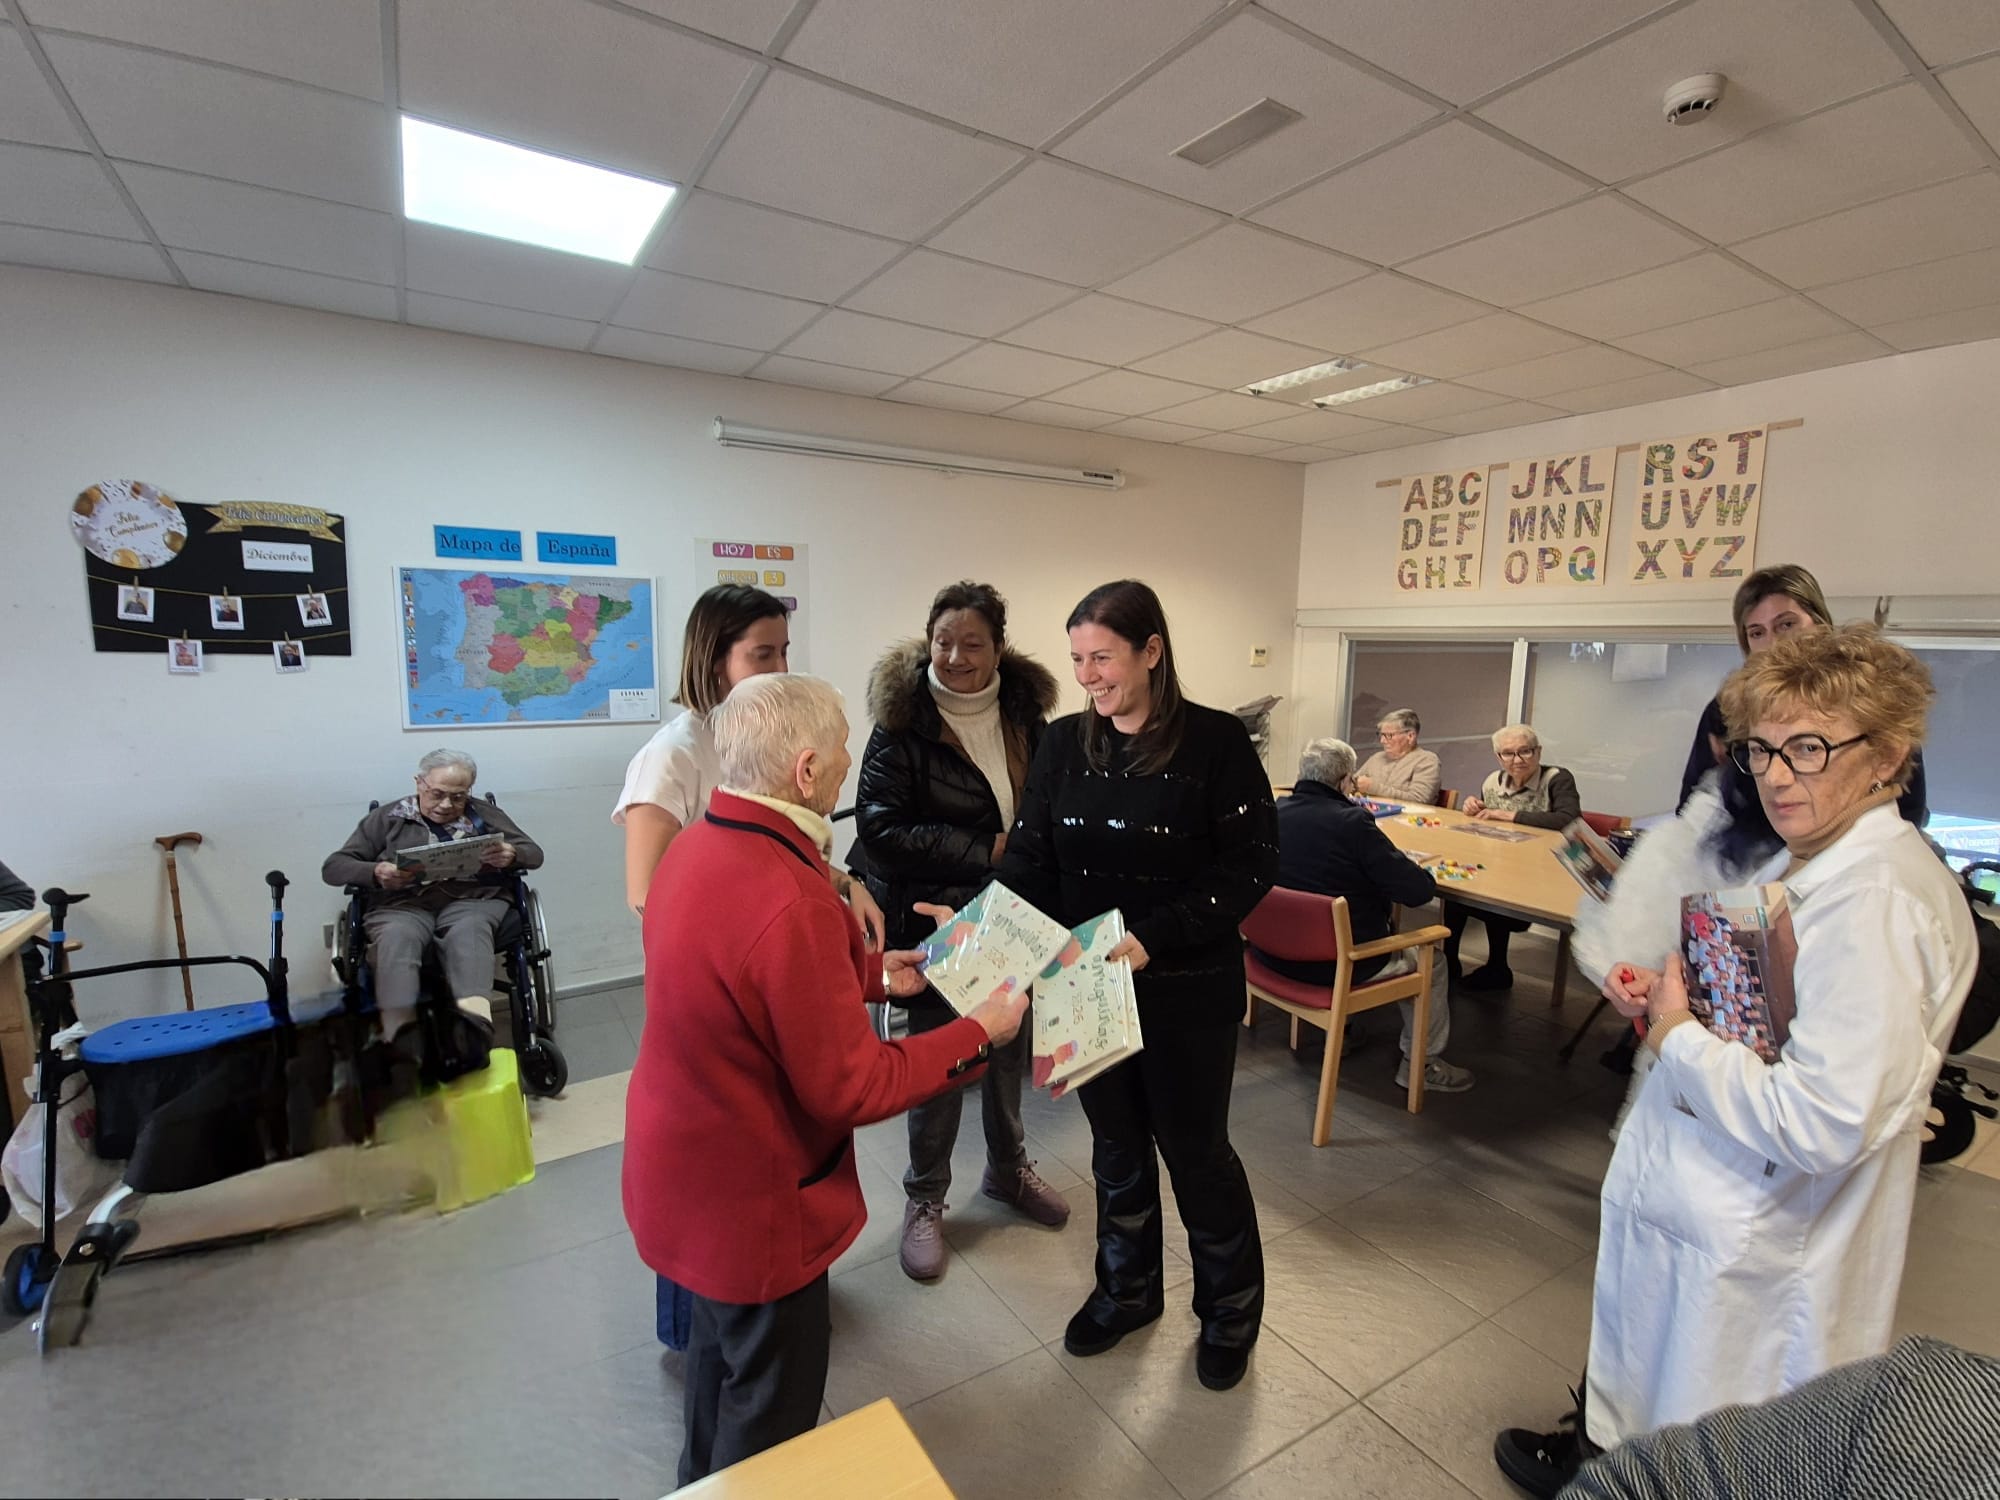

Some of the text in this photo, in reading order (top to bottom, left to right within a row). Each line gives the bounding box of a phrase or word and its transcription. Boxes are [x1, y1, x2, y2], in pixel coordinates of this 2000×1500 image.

[440, 533, 611, 559] Mapa de España
[719, 543, 781, 559] HOY ES
[246, 548, 309, 562] Diciembre
